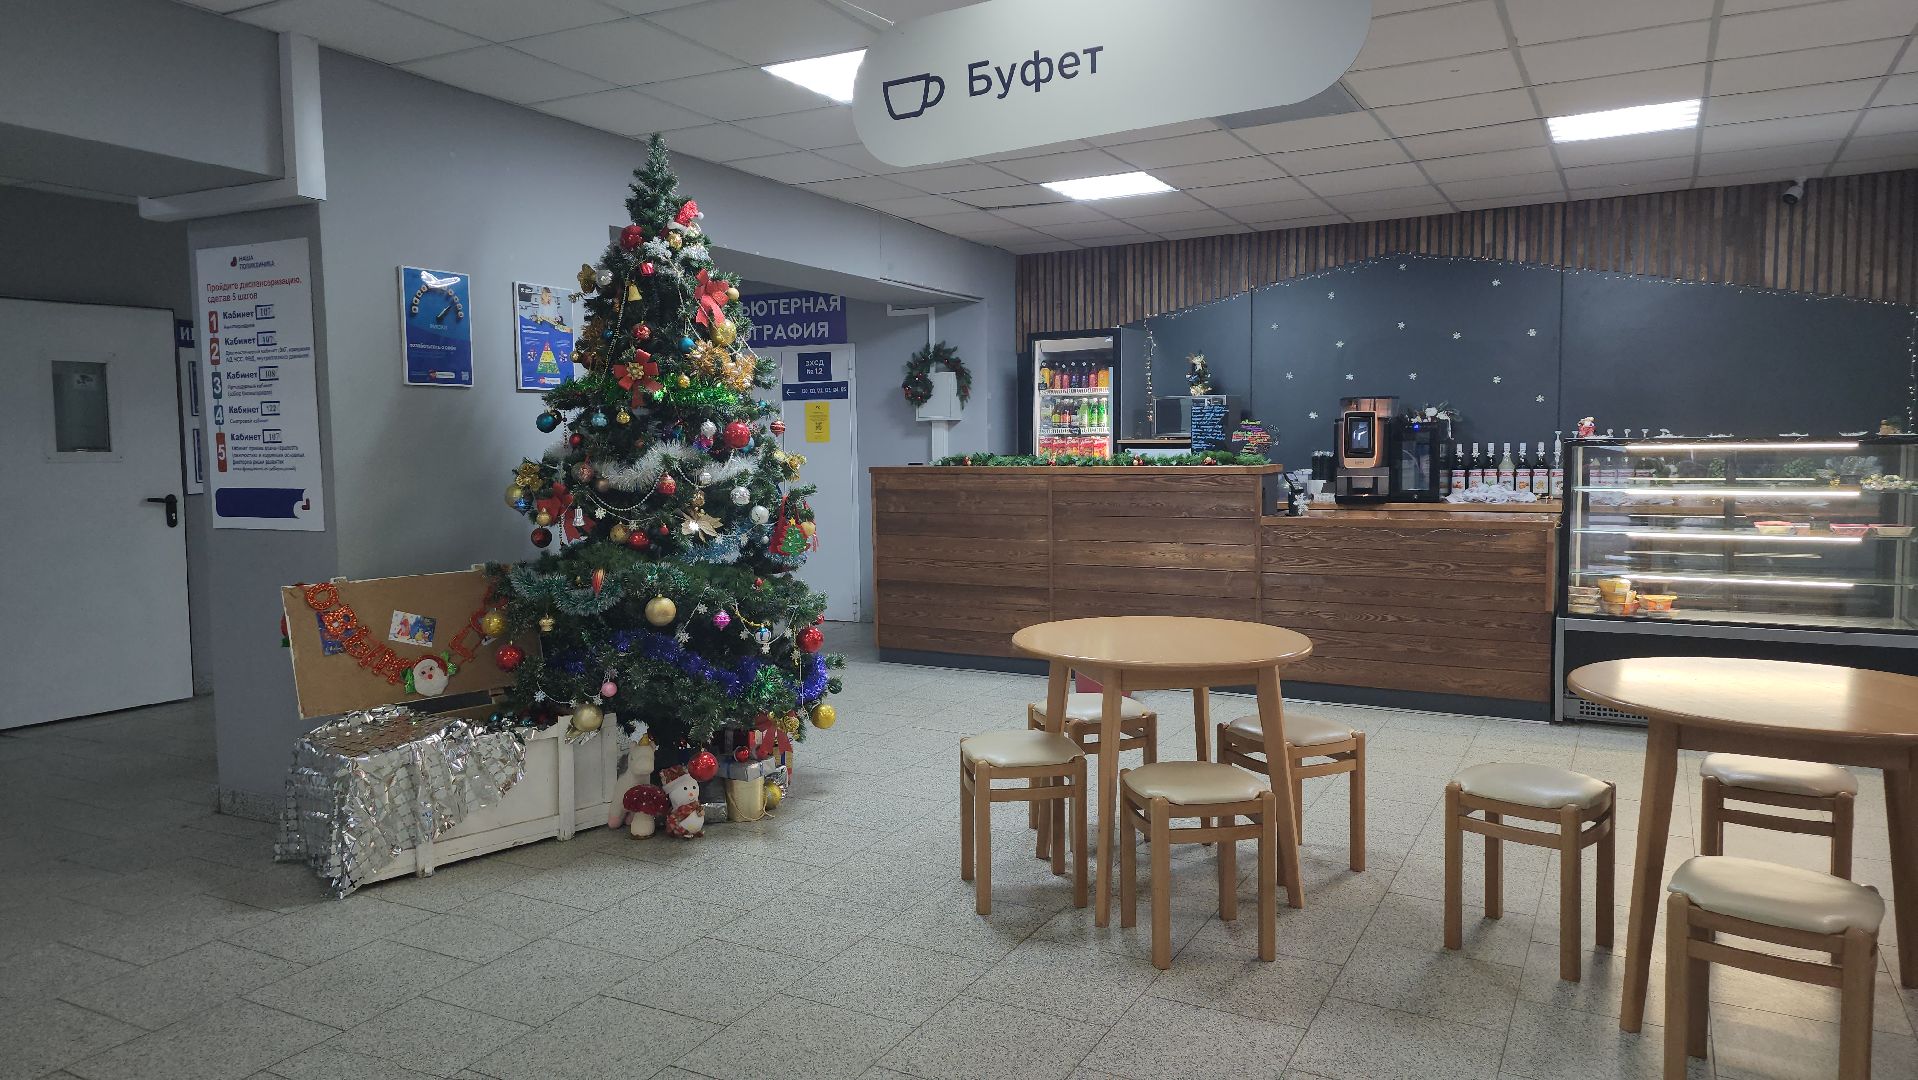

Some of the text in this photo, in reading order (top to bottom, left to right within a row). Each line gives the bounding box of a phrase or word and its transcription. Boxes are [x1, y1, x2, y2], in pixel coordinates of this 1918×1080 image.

[967, 45, 1104, 100] Буфет
[206, 281, 239, 293] Пройдите
[232, 292, 237, 301] 5
[237, 291, 258, 301] шагов
[222, 310, 254, 320] Кабинет
[224, 336, 256, 347] Кабинет
[226, 371, 258, 381] Кабинет
[228, 406, 260, 415] Кабинет
[230, 433, 261, 441] Кабинет
